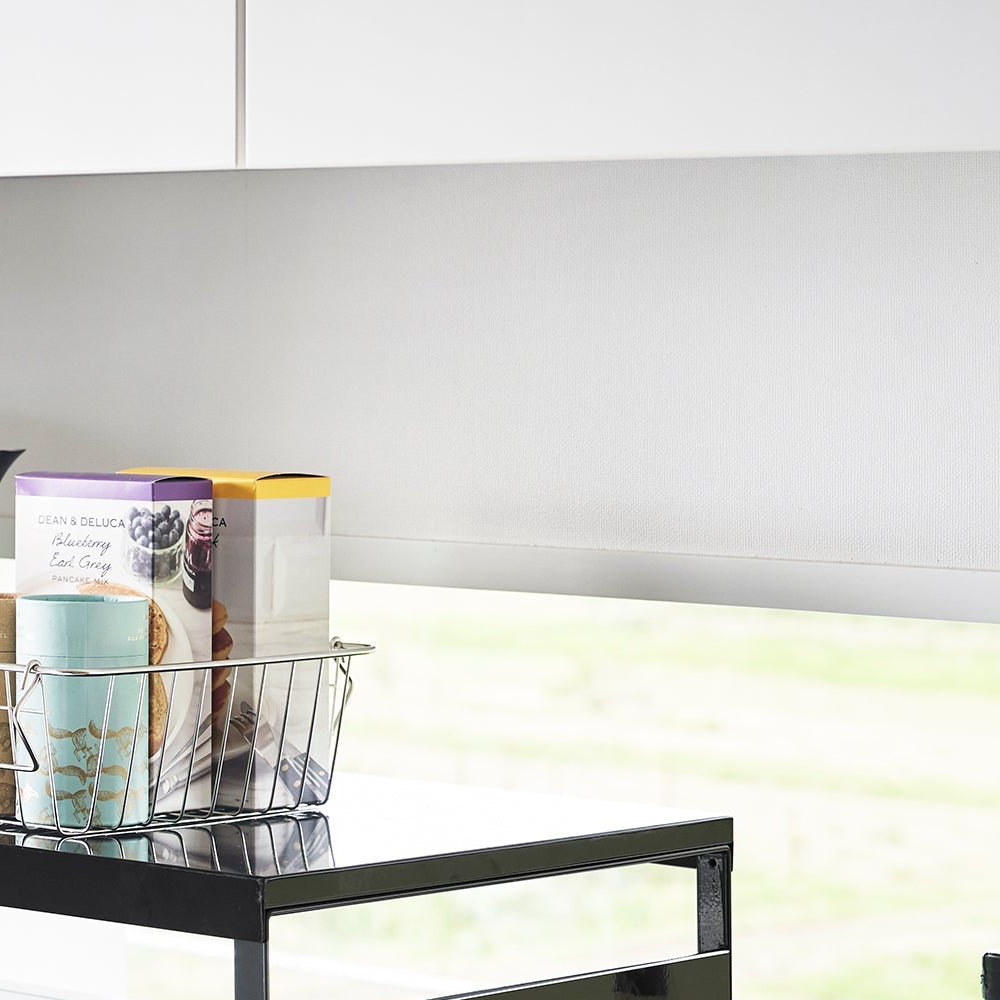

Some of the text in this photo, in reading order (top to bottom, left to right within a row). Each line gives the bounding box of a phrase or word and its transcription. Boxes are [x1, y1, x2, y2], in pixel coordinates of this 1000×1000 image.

[38, 514, 126, 529] DEAN & DELUCA
[51, 532, 112, 557] Blueberry
[49, 551, 112, 578] Earl Grey
[51, 574, 109, 586] PANCAKE MIX
